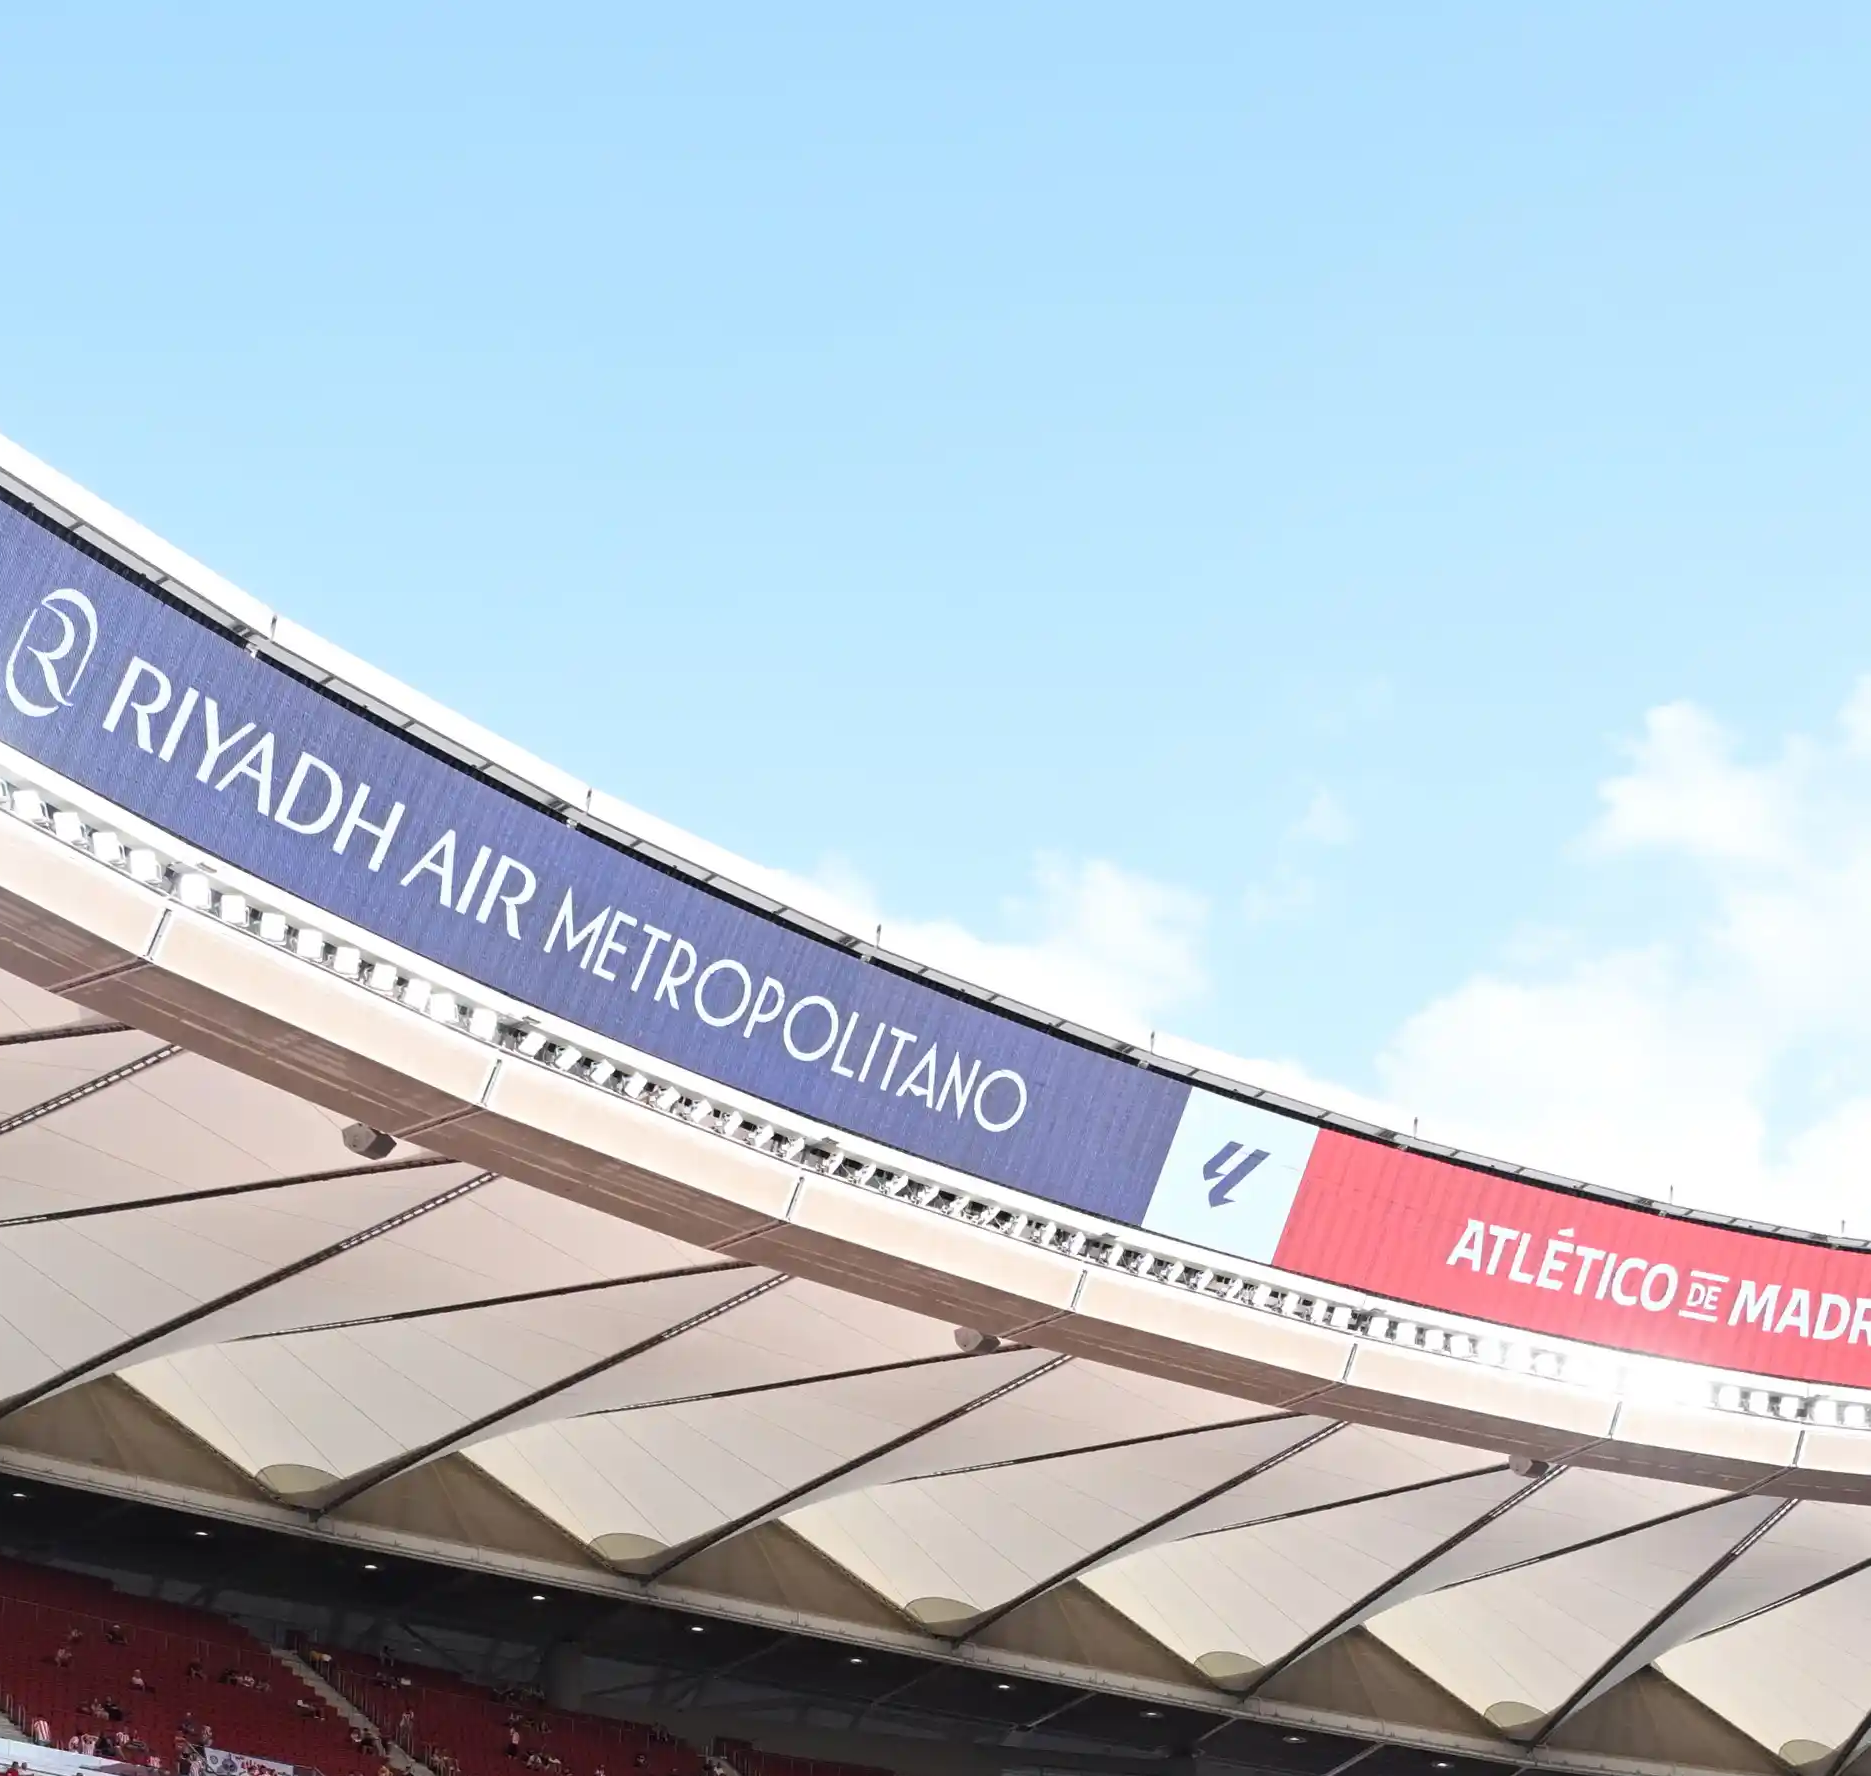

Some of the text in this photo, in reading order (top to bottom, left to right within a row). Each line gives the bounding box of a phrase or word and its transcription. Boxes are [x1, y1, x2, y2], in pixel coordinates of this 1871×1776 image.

[102, 655, 1028, 1132] RIYADH AIR METROPOLITANO
[1446, 1218, 1677, 1312] ATLÉTICO
[1682, 1277, 1723, 1315] DE
